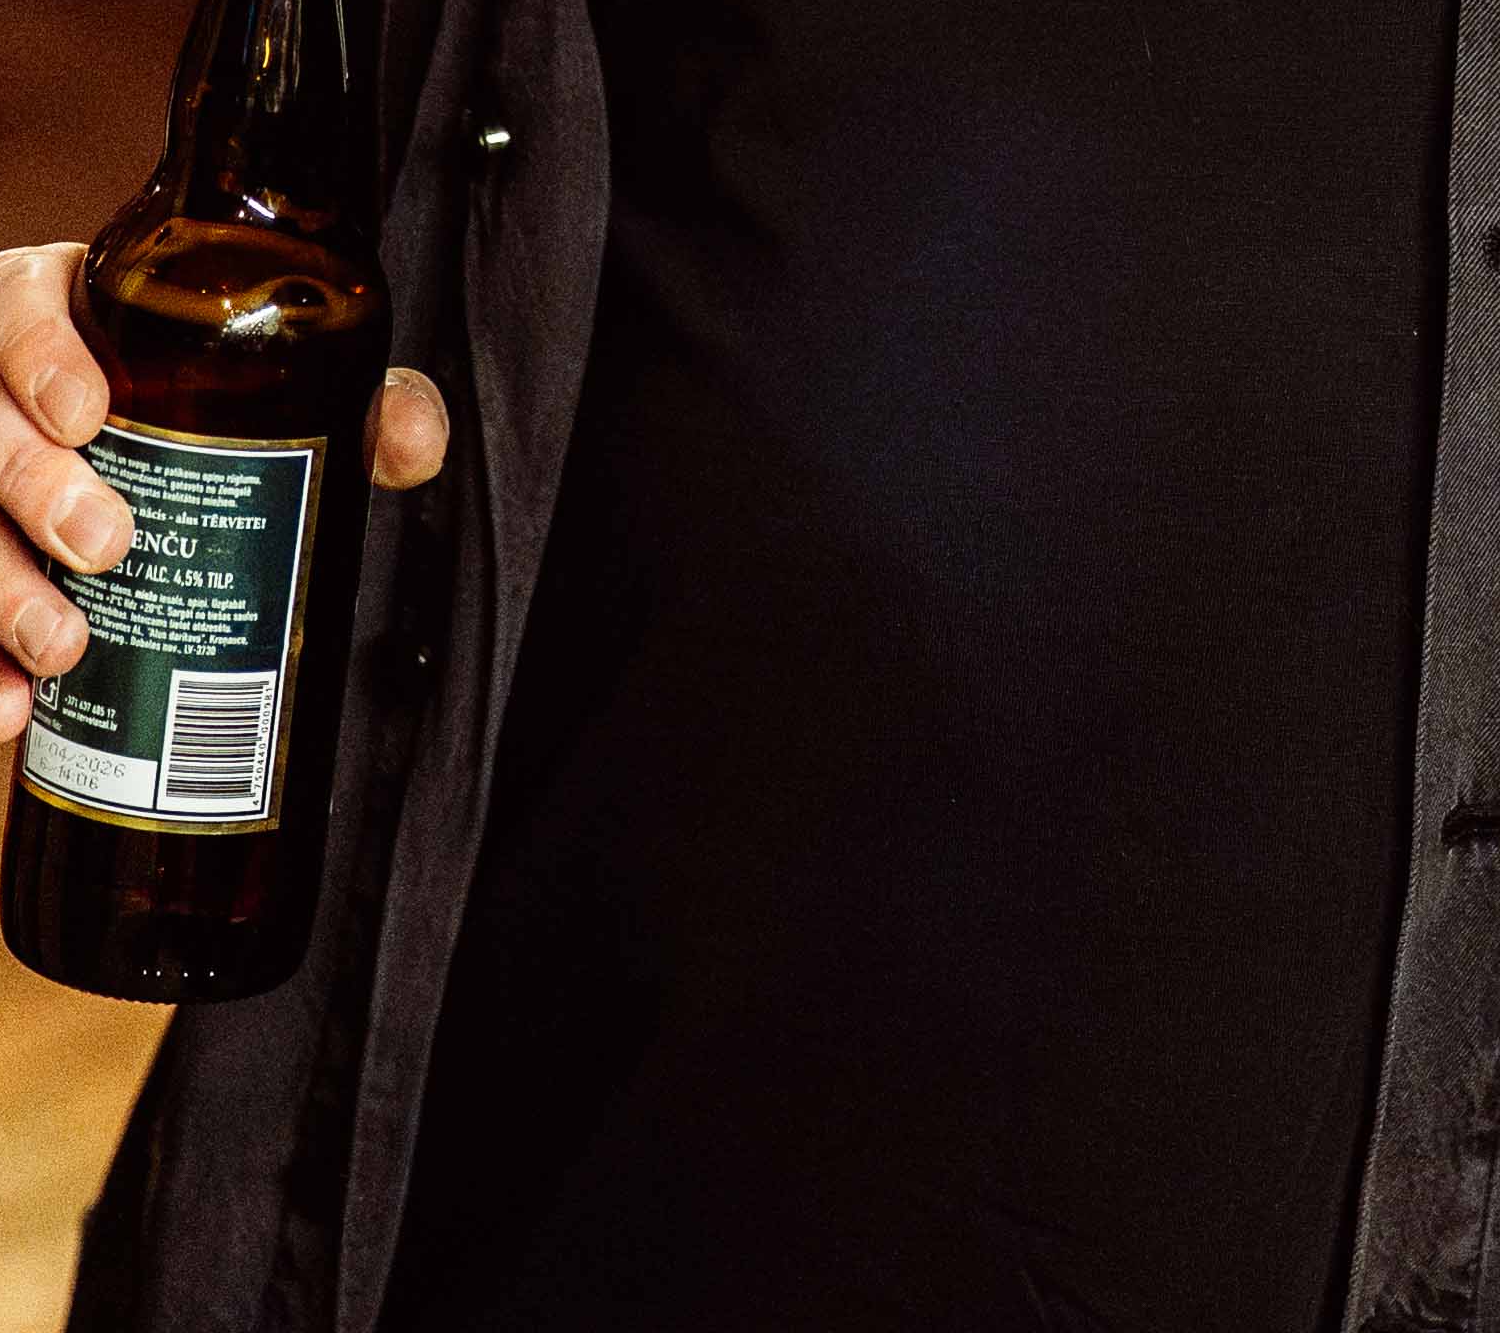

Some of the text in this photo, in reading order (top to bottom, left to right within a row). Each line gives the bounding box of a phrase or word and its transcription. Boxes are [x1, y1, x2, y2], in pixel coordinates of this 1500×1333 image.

[139, 503, 167, 521] nācis
[201, 514, 267, 530] TĒRVETE!
[130, 528, 199, 559] ENČU
[126, 559, 134, 577] L
[145, 564, 170, 584] ALC.
[173, 568, 204, 588] 4,5%
[207, 572, 234, 590] TILP.
